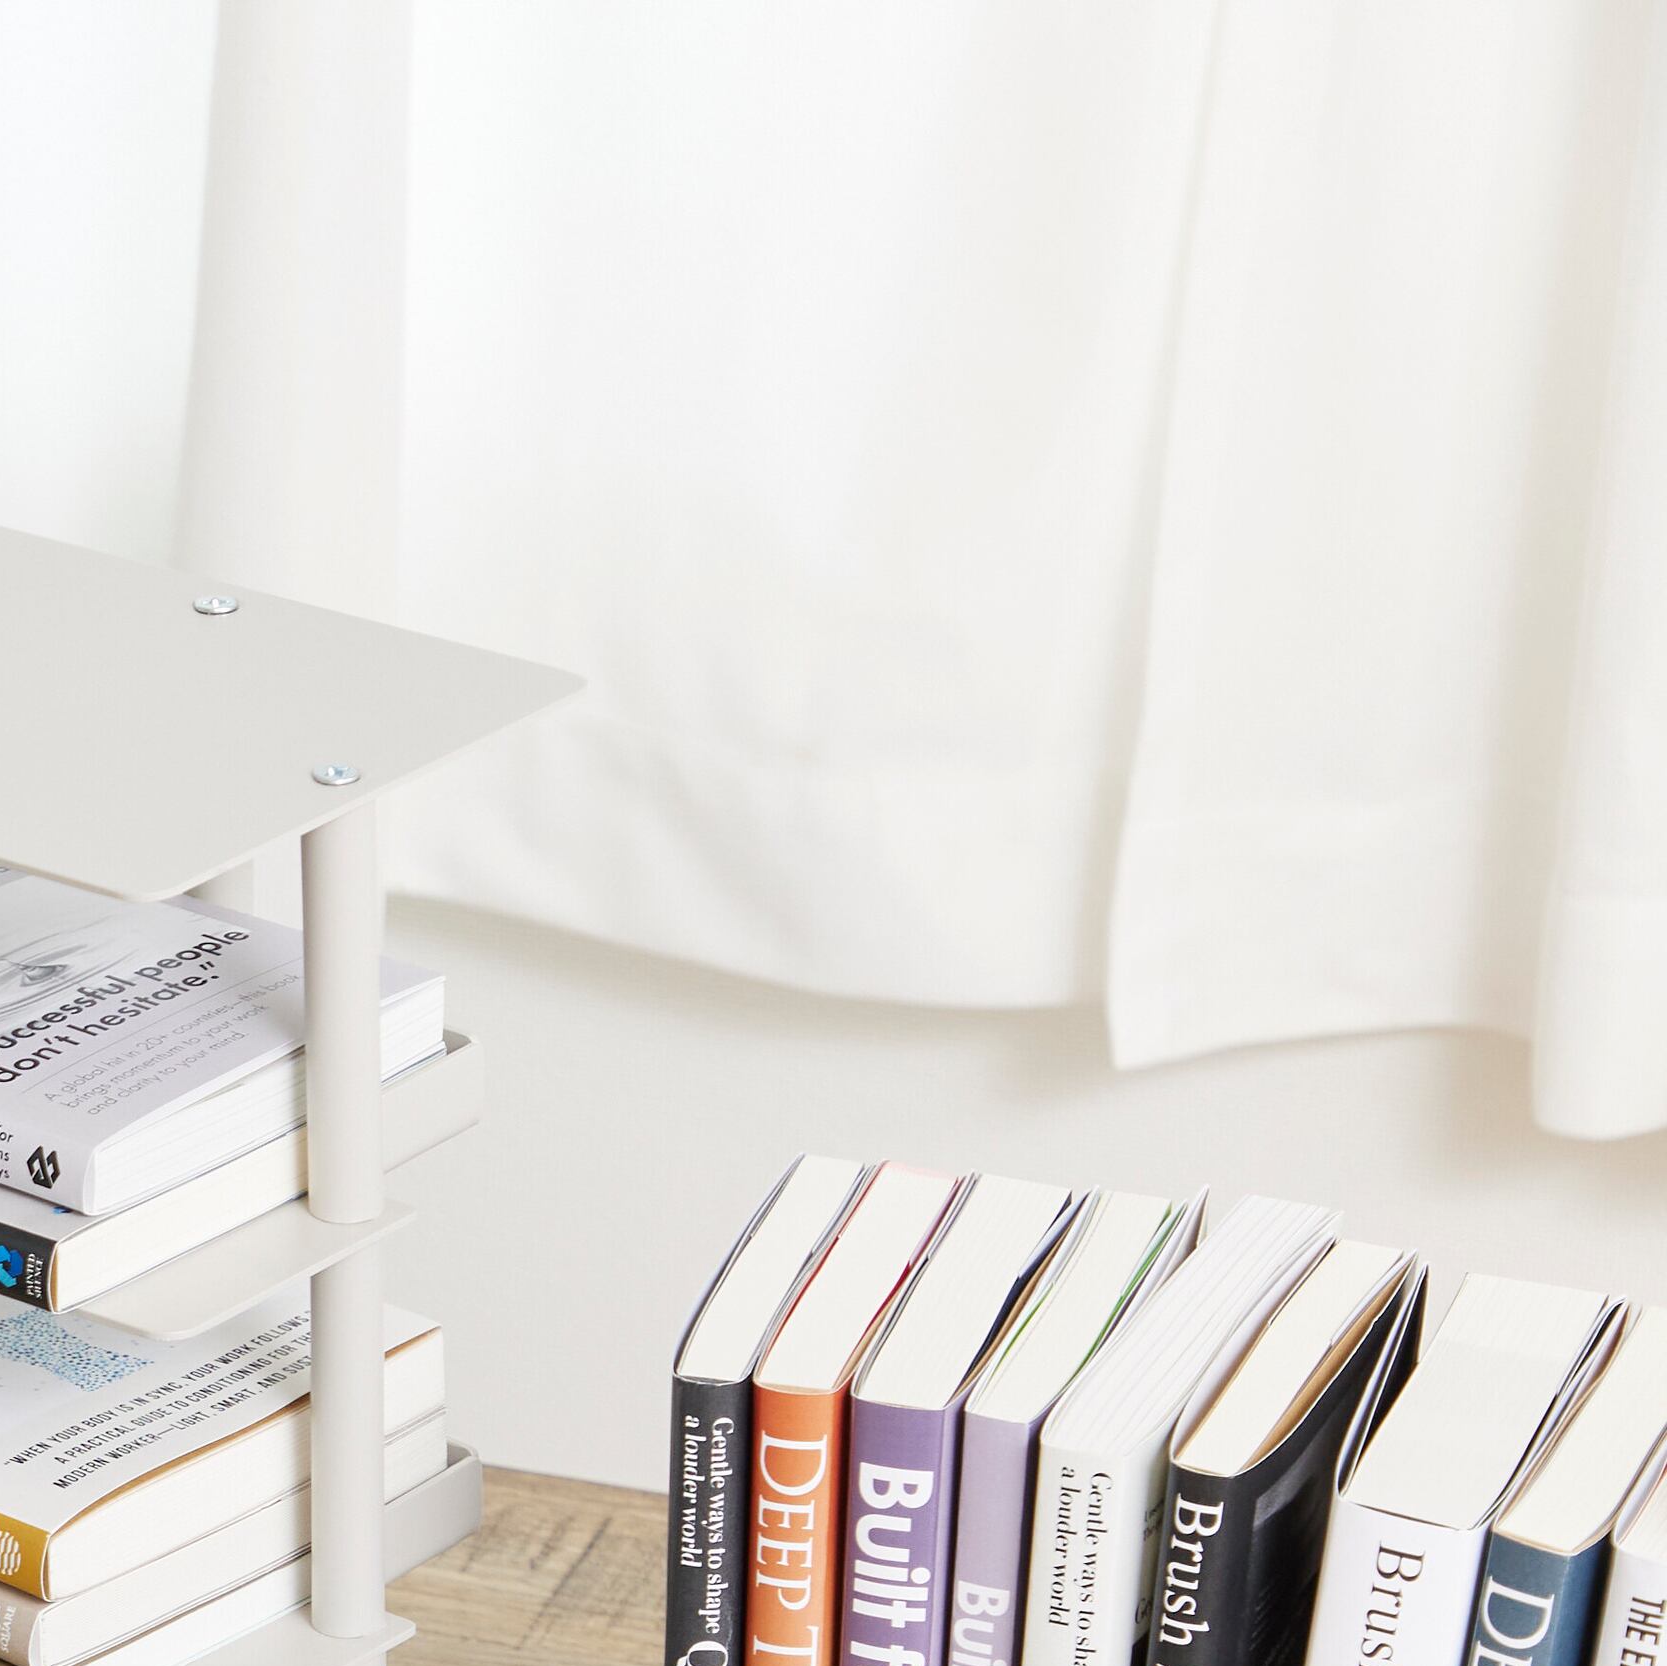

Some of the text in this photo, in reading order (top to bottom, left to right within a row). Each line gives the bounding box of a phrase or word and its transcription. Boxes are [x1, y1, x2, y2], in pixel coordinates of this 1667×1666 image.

[134, 929, 249, 984] people
[680, 1415, 707, 1568] a louder world
[697, 1416, 735, 1635] Gentle ways to shape
[755, 1430, 827, 1611] DEEP
[852, 1462, 934, 1628] Built
[1158, 1492, 1224, 1647] Brush
[1625, 1595, 1667, 1646] THE
